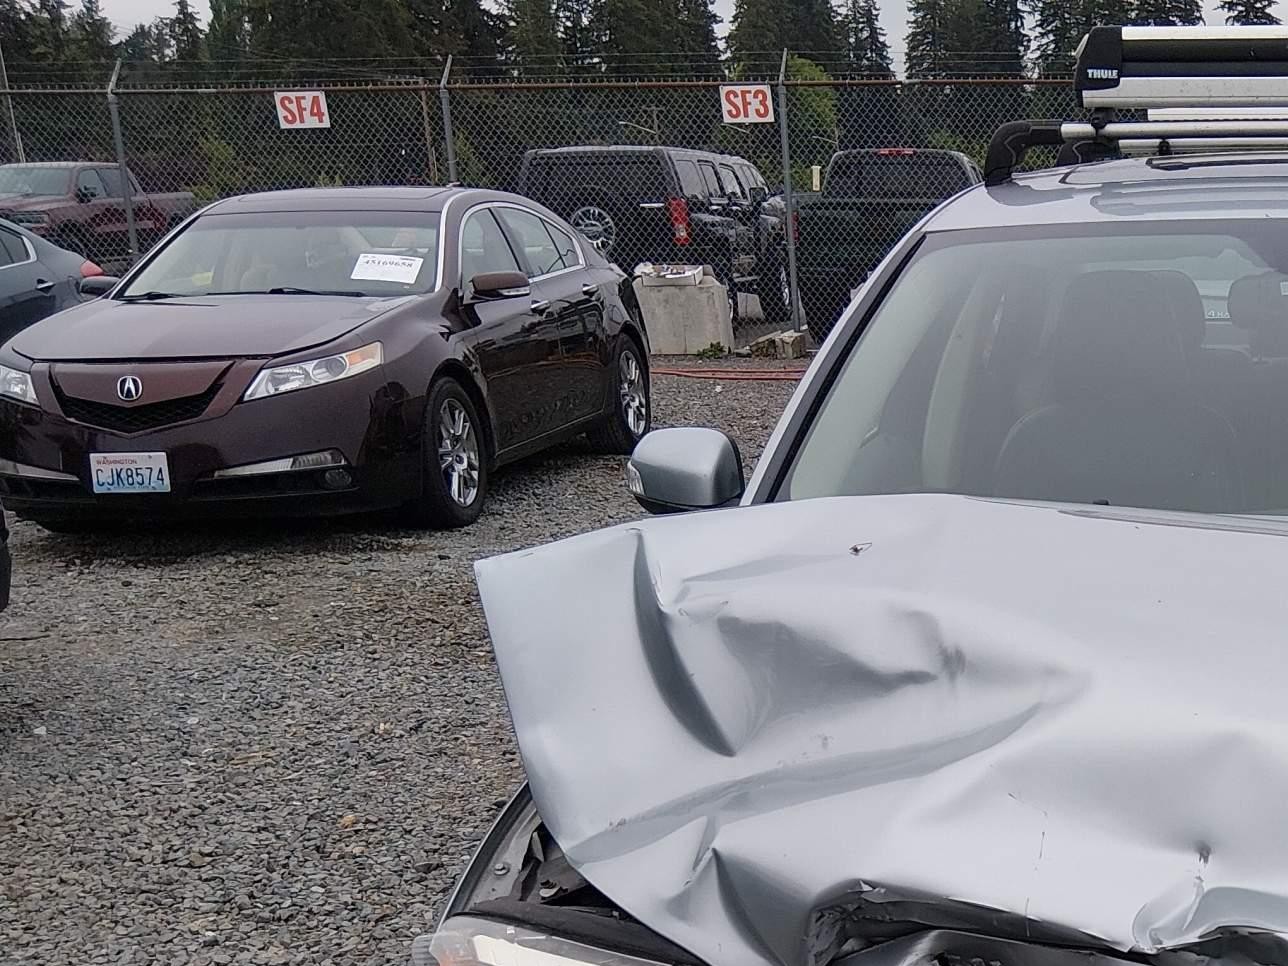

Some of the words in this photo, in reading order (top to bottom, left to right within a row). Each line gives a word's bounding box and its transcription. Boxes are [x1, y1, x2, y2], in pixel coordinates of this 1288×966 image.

[1087, 69, 1119, 79] THULE
[279, 95, 325, 125] SF4
[724, 88, 770, 119] SF3
[95, 467, 165, 487] CJK8574
